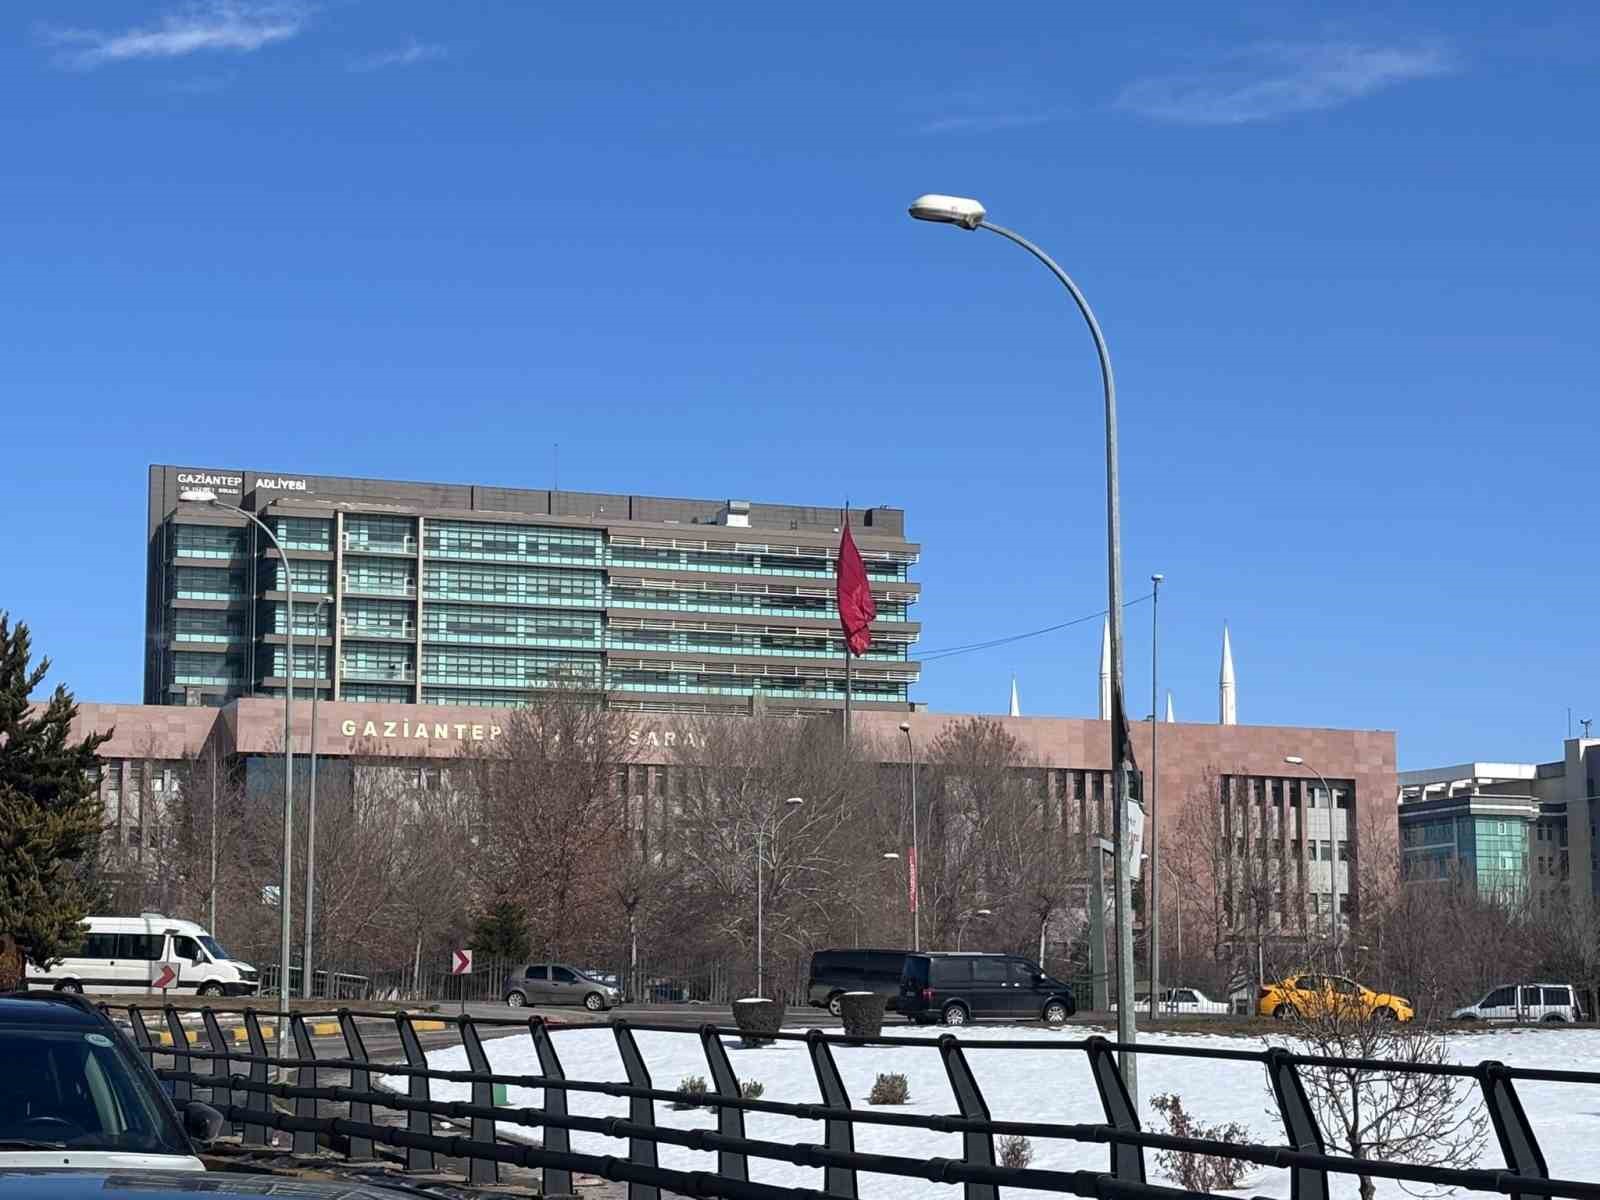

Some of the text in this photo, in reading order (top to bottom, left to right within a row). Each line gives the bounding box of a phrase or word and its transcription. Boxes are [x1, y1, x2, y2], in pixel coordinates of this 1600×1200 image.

[177, 473, 306, 490] GAZİANTEP ADLİYESİ
[341, 719, 502, 740] GAZİANTEP
